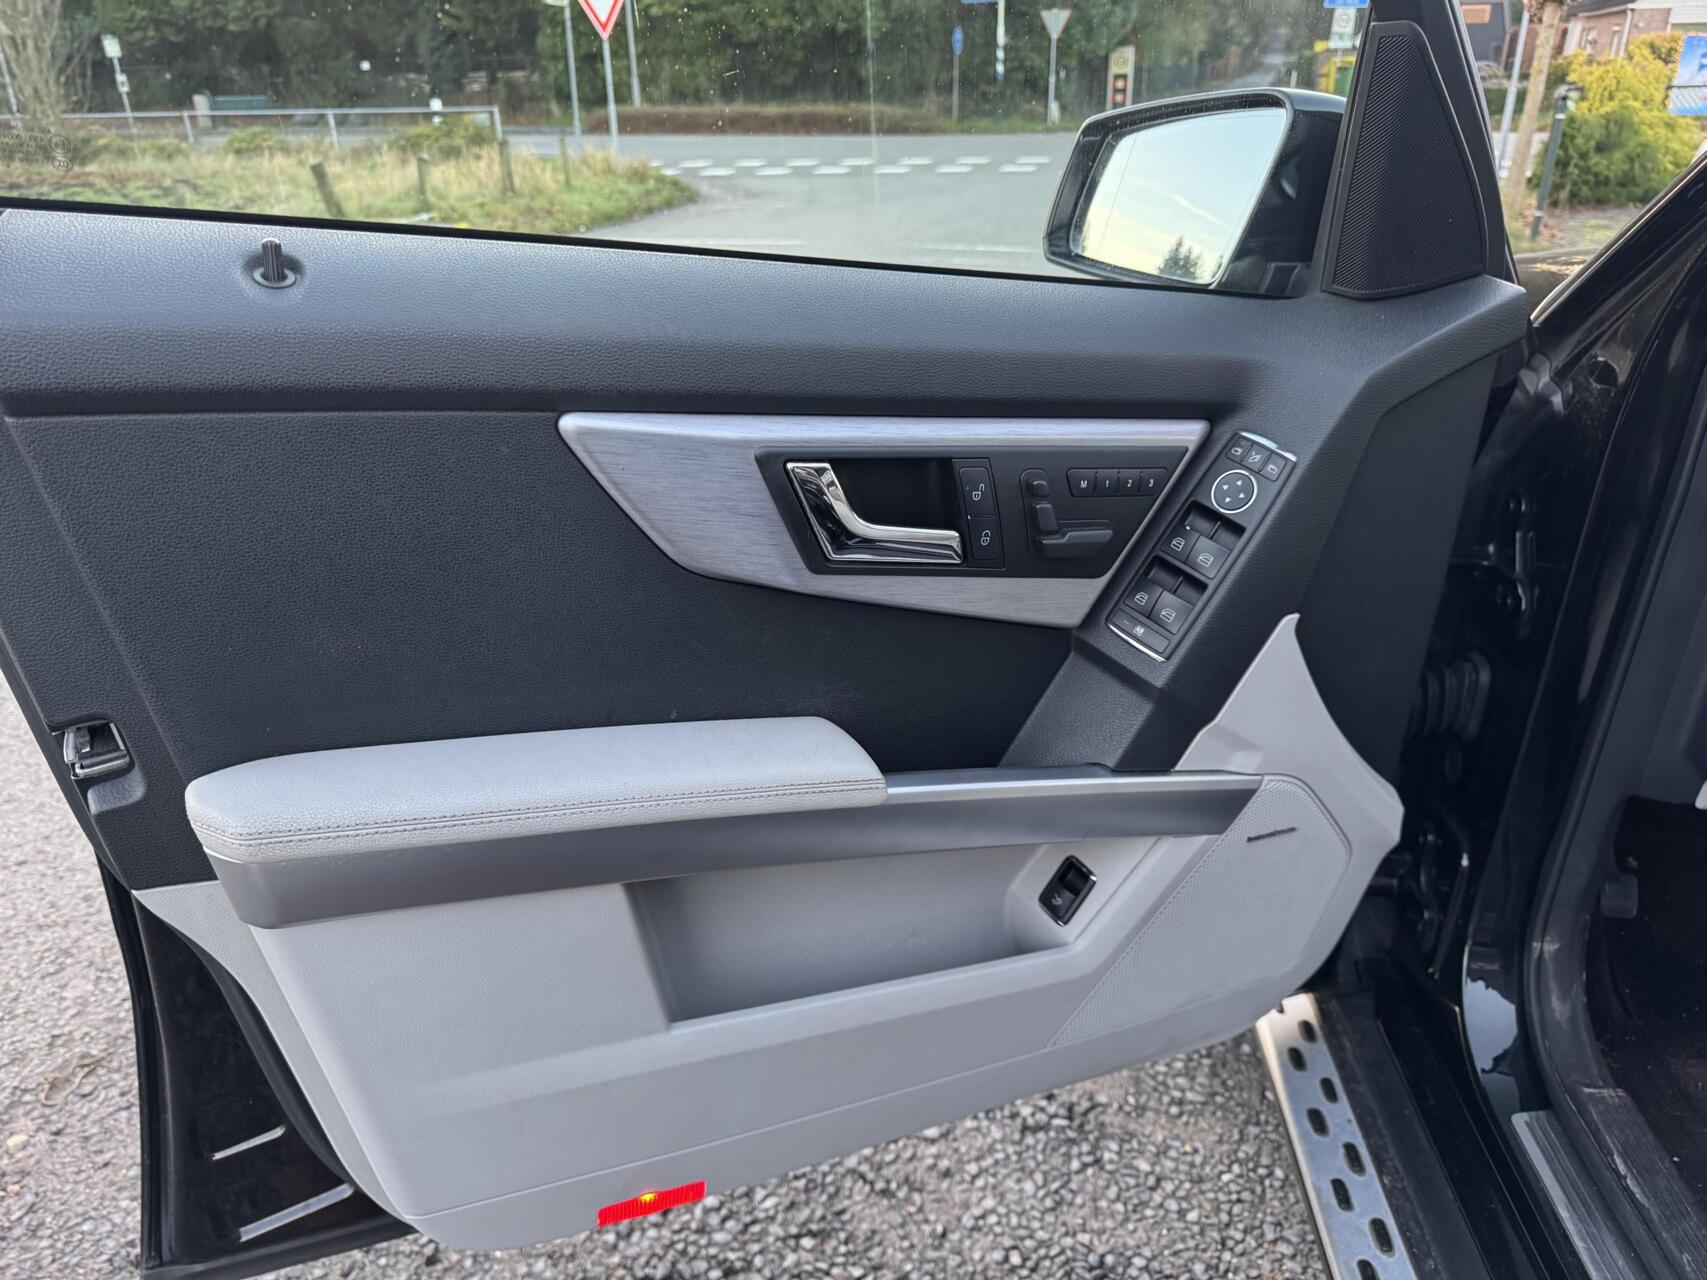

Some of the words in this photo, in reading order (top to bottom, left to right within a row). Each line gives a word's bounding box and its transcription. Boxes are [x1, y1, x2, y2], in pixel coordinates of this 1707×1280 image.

[1080, 479, 1088, 488] M
[1127, 479, 1133, 488] 2
[1148, 479, 1154, 488] 3
